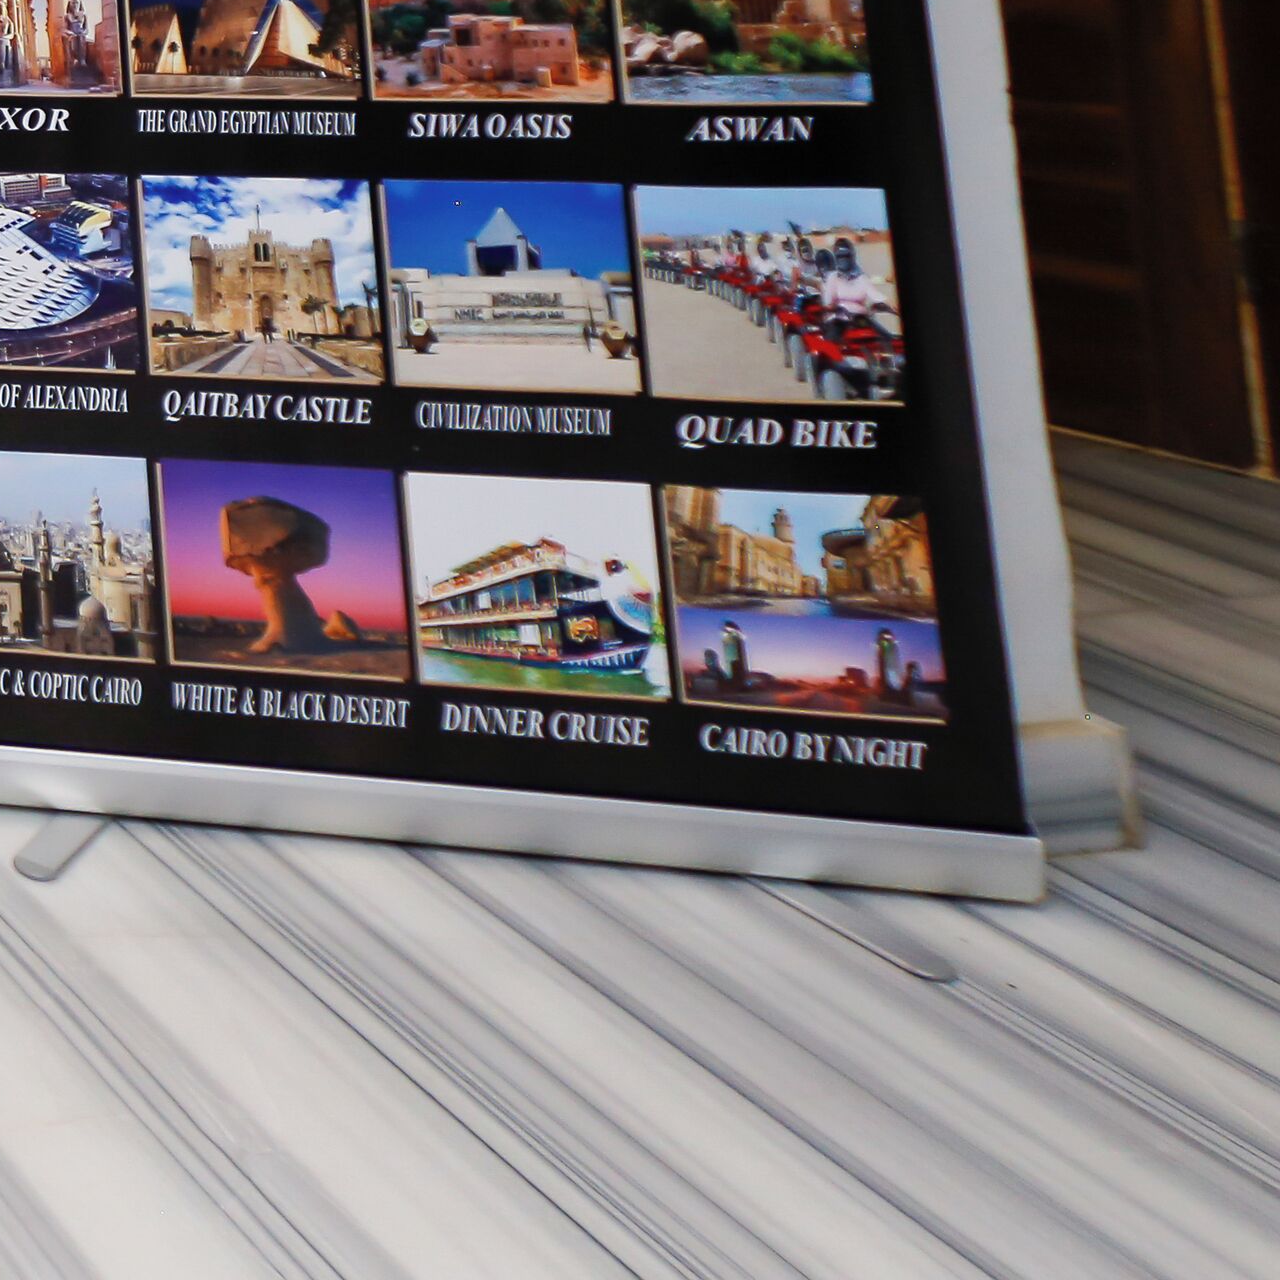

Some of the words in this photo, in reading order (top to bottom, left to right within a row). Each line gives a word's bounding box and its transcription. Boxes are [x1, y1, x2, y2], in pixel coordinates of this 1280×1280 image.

[138, 109, 166, 132] THE
[169, 110, 217, 133] GRAND
[220, 111, 290, 135] EGYPTIAN
[293, 112, 356, 136] MUSEUM
[408, 113, 481, 138] SIWA
[487, 114, 572, 139] OASIS
[685, 116, 814, 143] ASWAN
[24, 385, 128, 413] ALEXANDRIA
[163, 389, 270, 421] QAITBAY
[274, 394, 372, 424] CASTLE
[415, 401, 533, 432] CIVILIZATION
[535, 406, 611, 436] MUSEUM
[677, 415, 784, 449] QUAD
[791, 420, 877, 449] BIKE
[14, 669, 25, 697] &
[29, 671, 89, 702] COPTIC
[92, 676, 142, 706] CAIRO
[172, 682, 237, 714] WHITE
[242, 687, 256, 714] &
[262, 689, 325, 721] BLACK
[330, 694, 410, 728] DESERT
[442, 704, 543, 739] DINNER
[548, 711, 649, 747] CRUISE
[700, 724, 788, 759] CAIRO
[792, 732, 829, 762] BY
[835, 735, 927, 770] NIGHT
